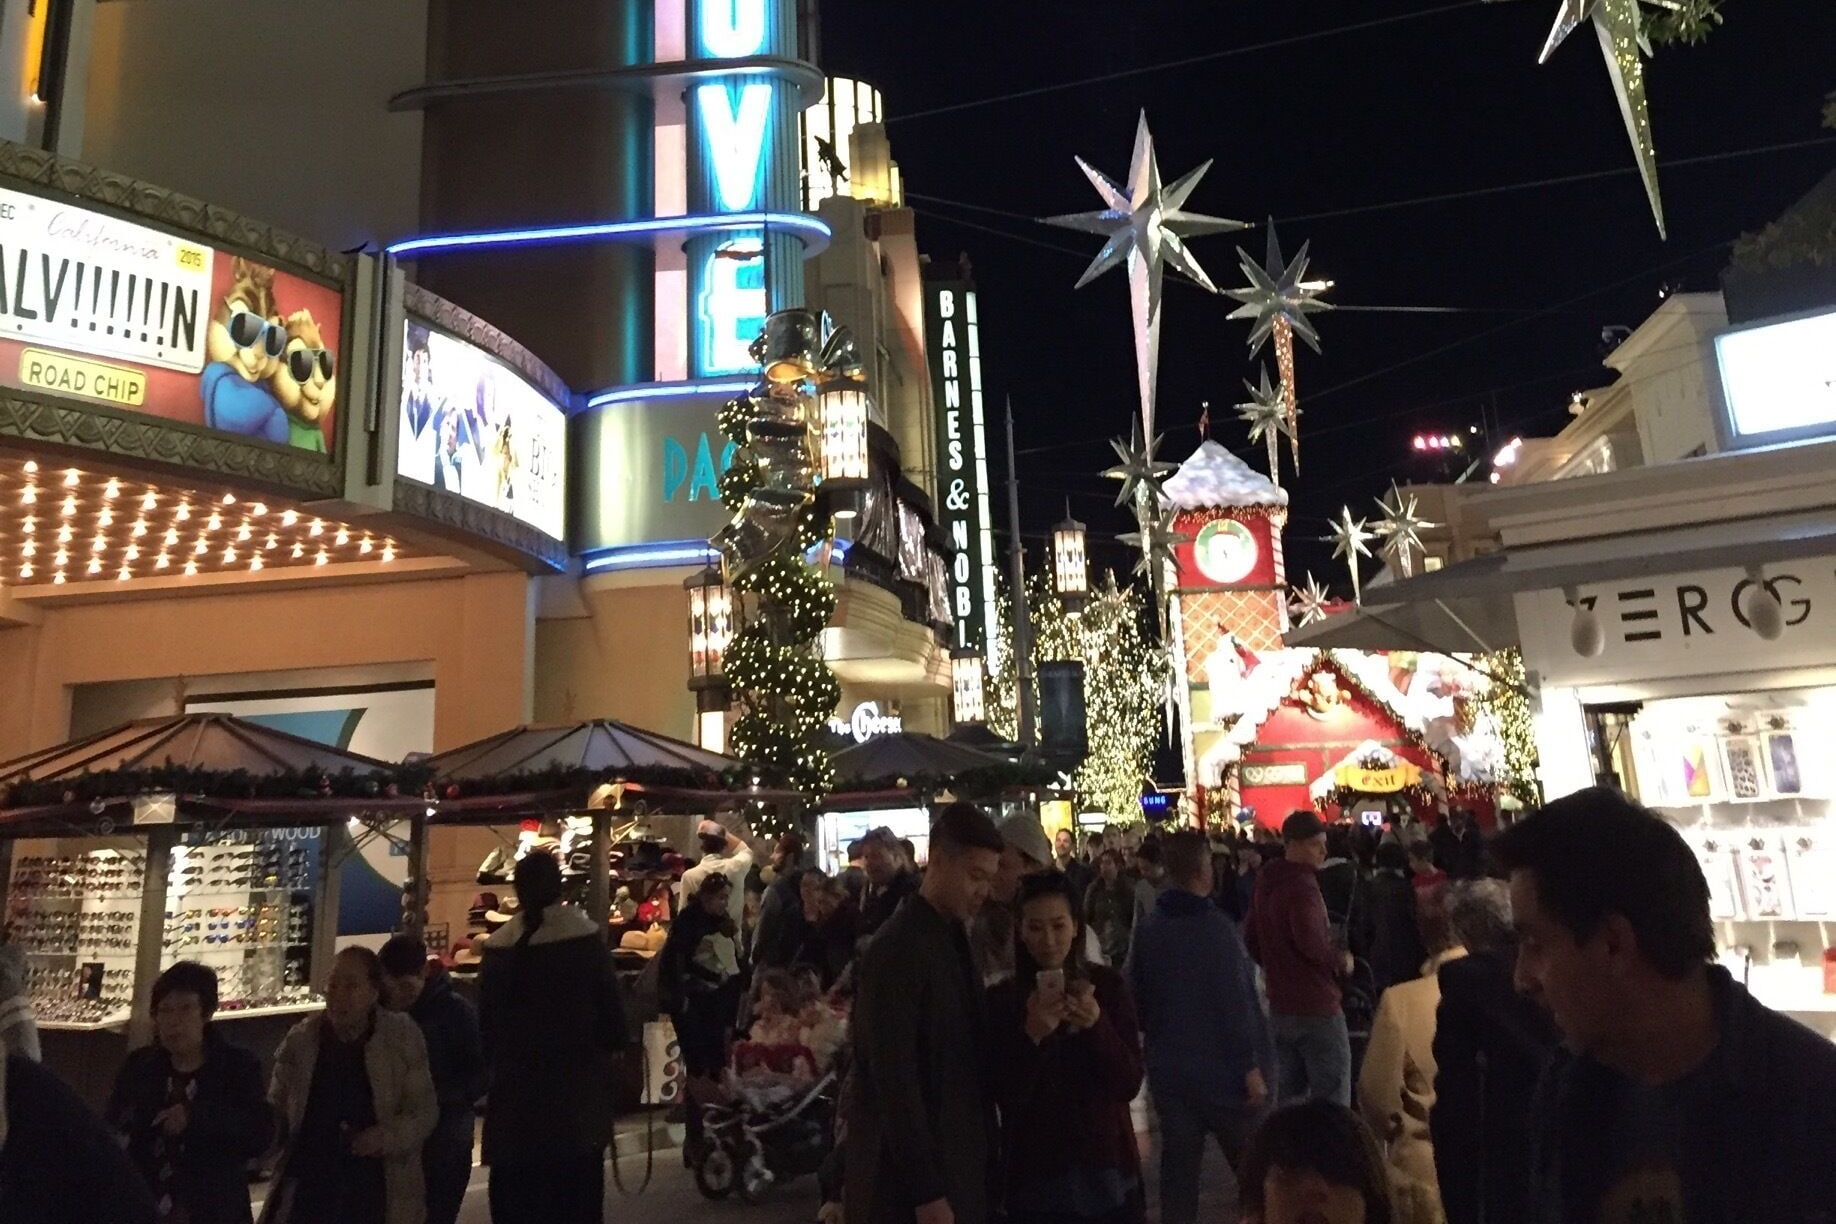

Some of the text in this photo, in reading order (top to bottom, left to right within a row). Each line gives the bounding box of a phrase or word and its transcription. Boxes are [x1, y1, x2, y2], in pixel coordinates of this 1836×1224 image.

[179, 249, 202, 267] 2015
[29, 361, 139, 401] ROAD CHIP
[939, 290, 973, 649] BARNES & NOBL
